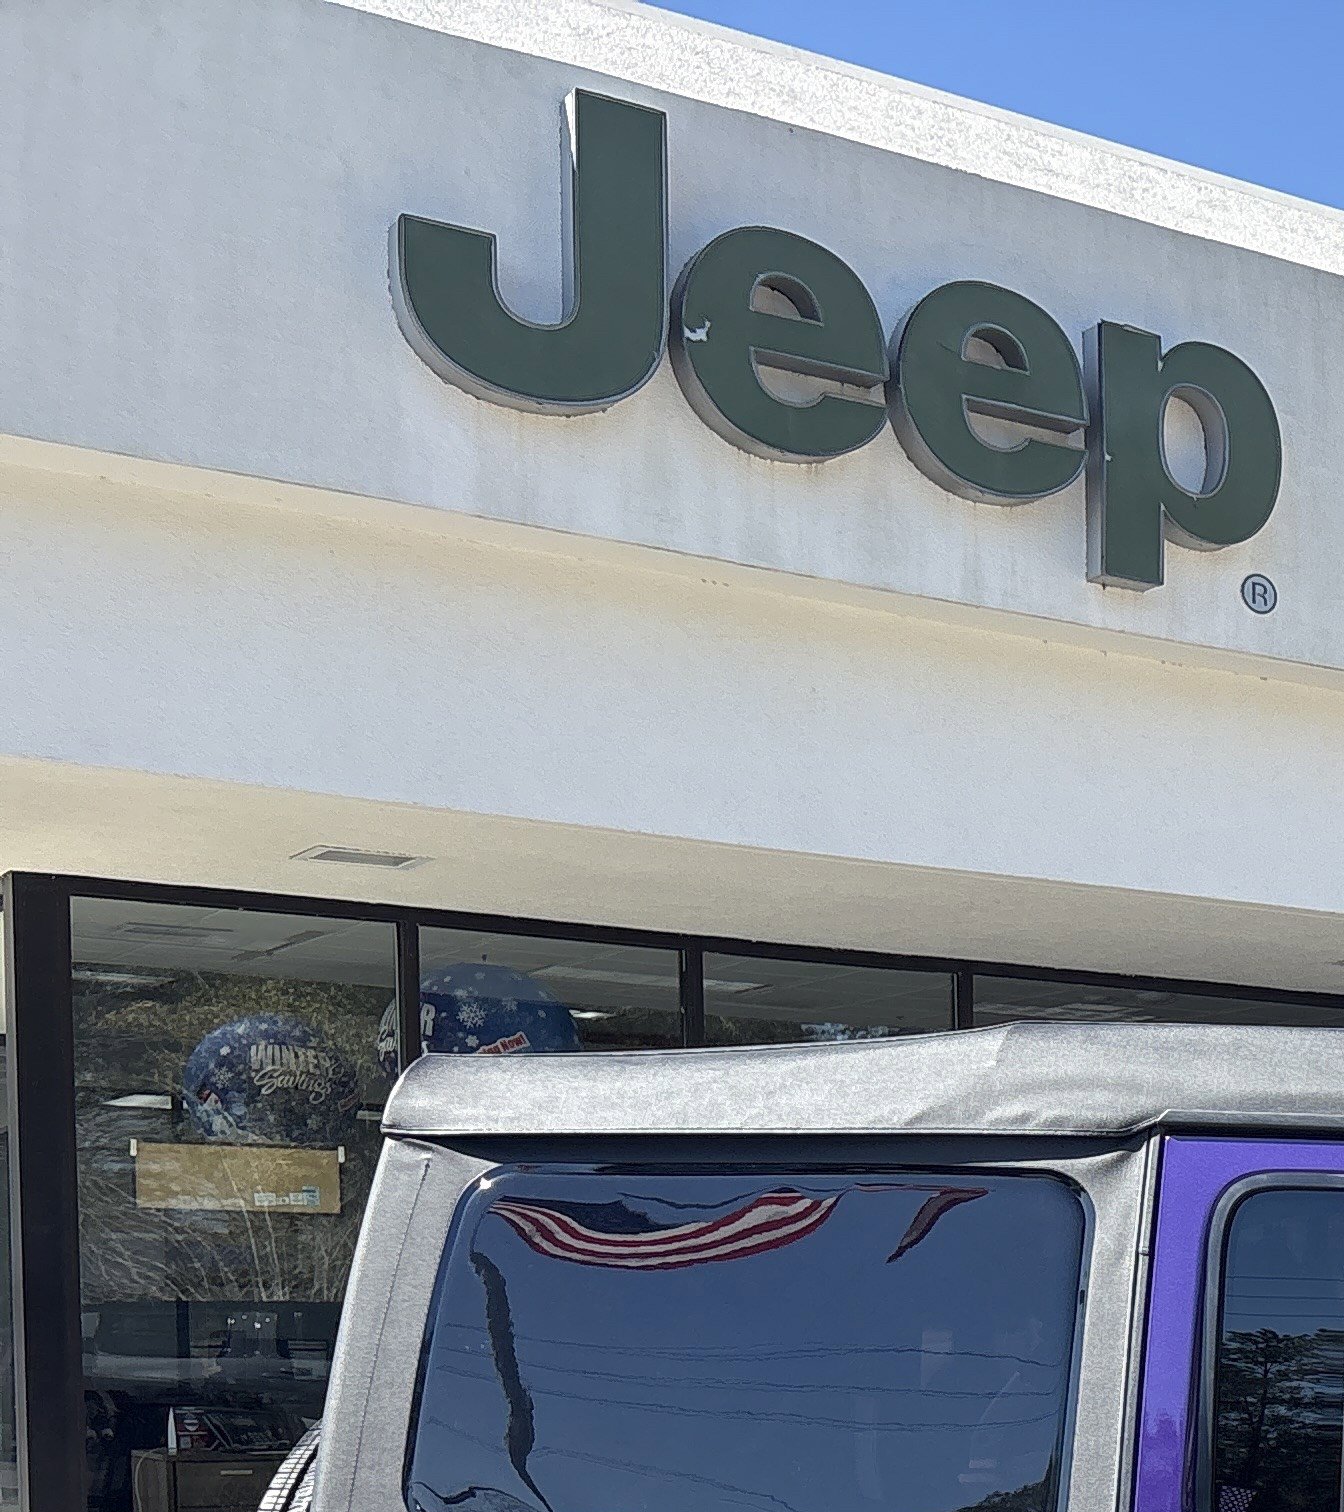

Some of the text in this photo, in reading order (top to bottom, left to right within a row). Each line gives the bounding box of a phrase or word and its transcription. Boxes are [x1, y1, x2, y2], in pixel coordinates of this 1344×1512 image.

[389, 88, 1282, 590] Jeep
[250, 1043, 332, 1077] WINTER
[253, 1065, 332, 1104] Savings
